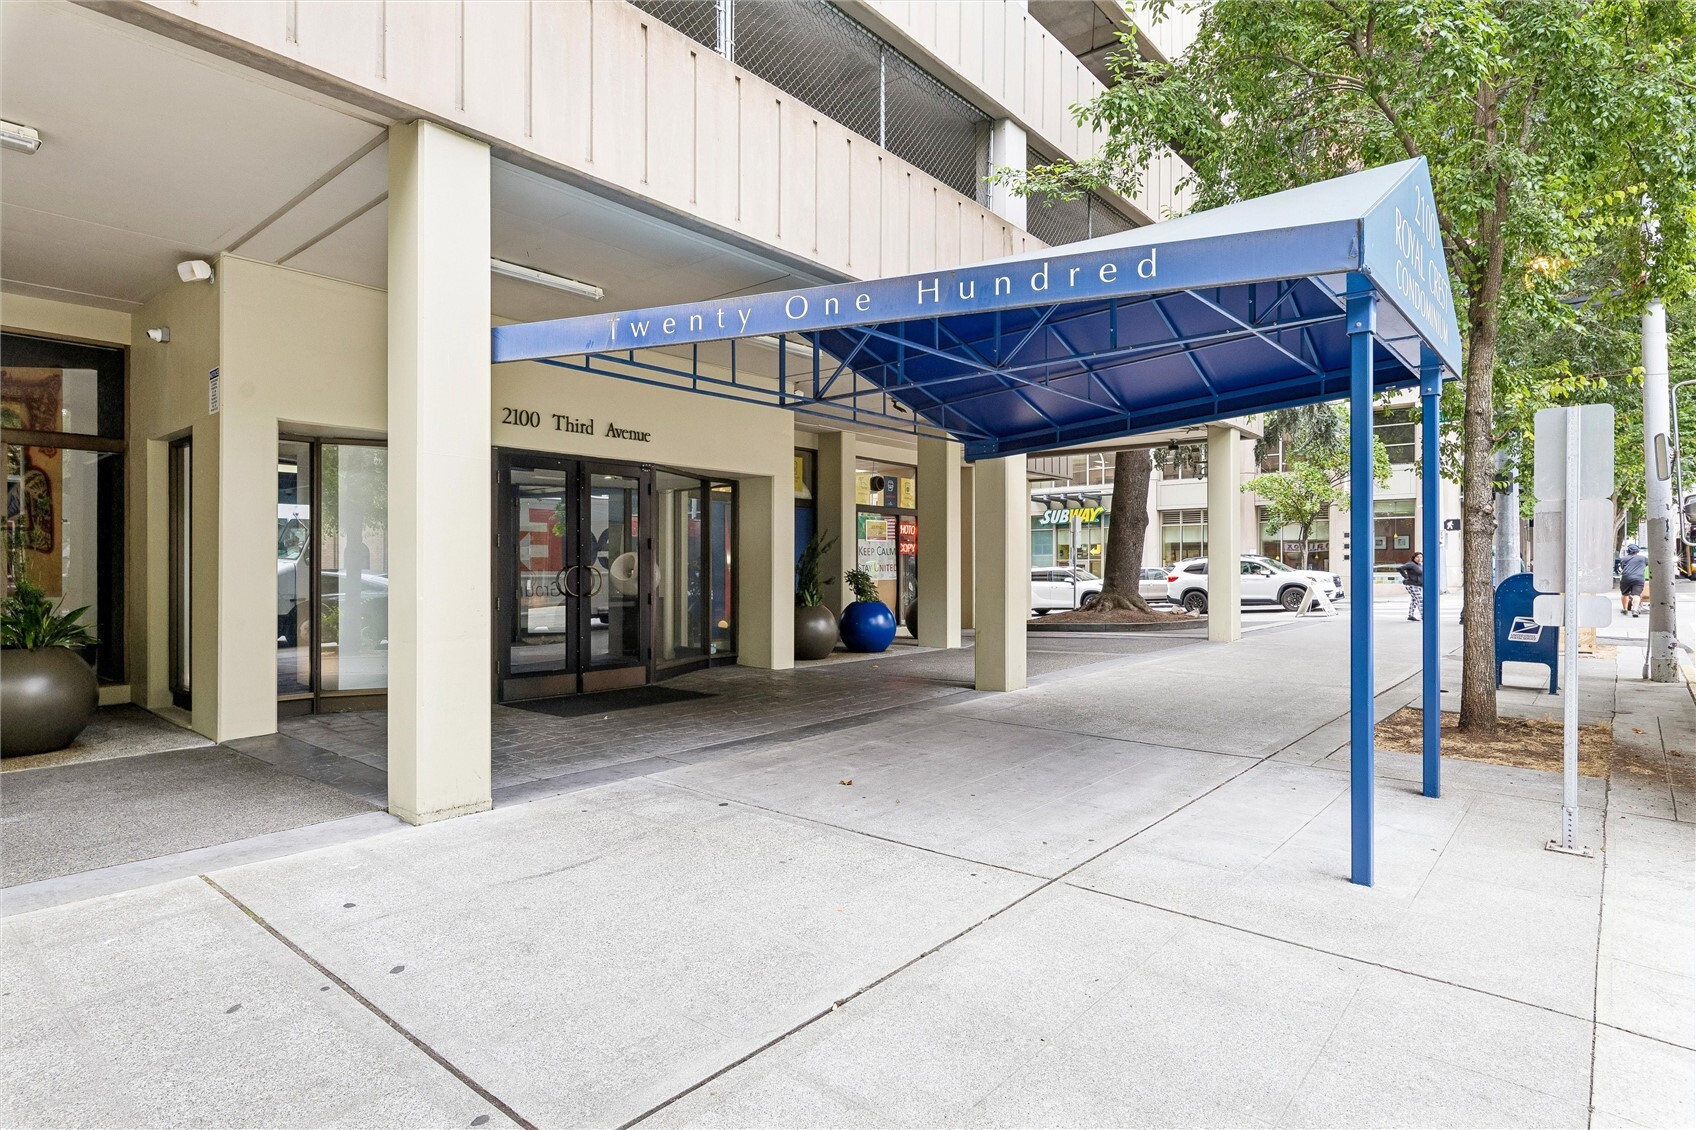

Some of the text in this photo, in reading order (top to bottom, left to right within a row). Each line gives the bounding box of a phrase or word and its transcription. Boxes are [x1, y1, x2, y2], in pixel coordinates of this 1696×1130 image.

[1415, 185, 1436, 250] 2100
[1395, 206, 1449, 314] ROYAL CREST
[607, 248, 1157, 341] Twenty One Hundred
[1394, 258, 1449, 347] CONDOMINIUM
[501, 407, 651, 443] 2100 Third Avenue
[900, 524, 915, 535] HOTO
[1040, 506, 1105, 525] SUBWAY
[858, 545, 896, 556] KEEP CALM
